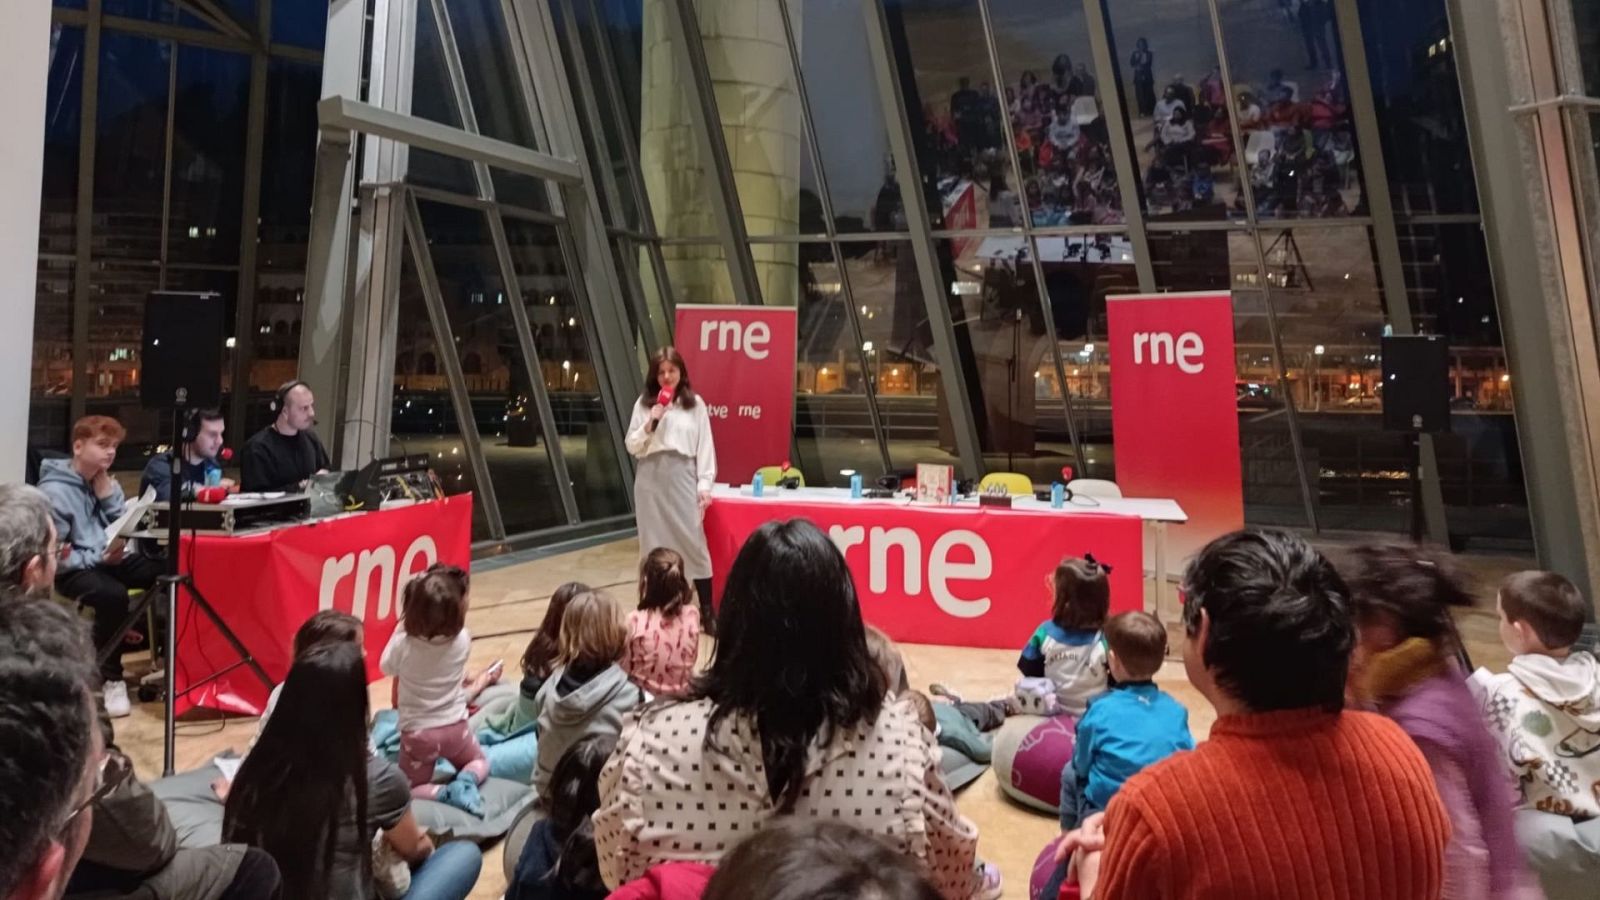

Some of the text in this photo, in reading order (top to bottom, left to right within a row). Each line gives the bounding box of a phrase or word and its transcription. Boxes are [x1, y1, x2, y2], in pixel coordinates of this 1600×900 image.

[700, 320, 771, 360] rne
[1133, 331, 1205, 374] rne
[707, 404, 761, 419] tve rne
